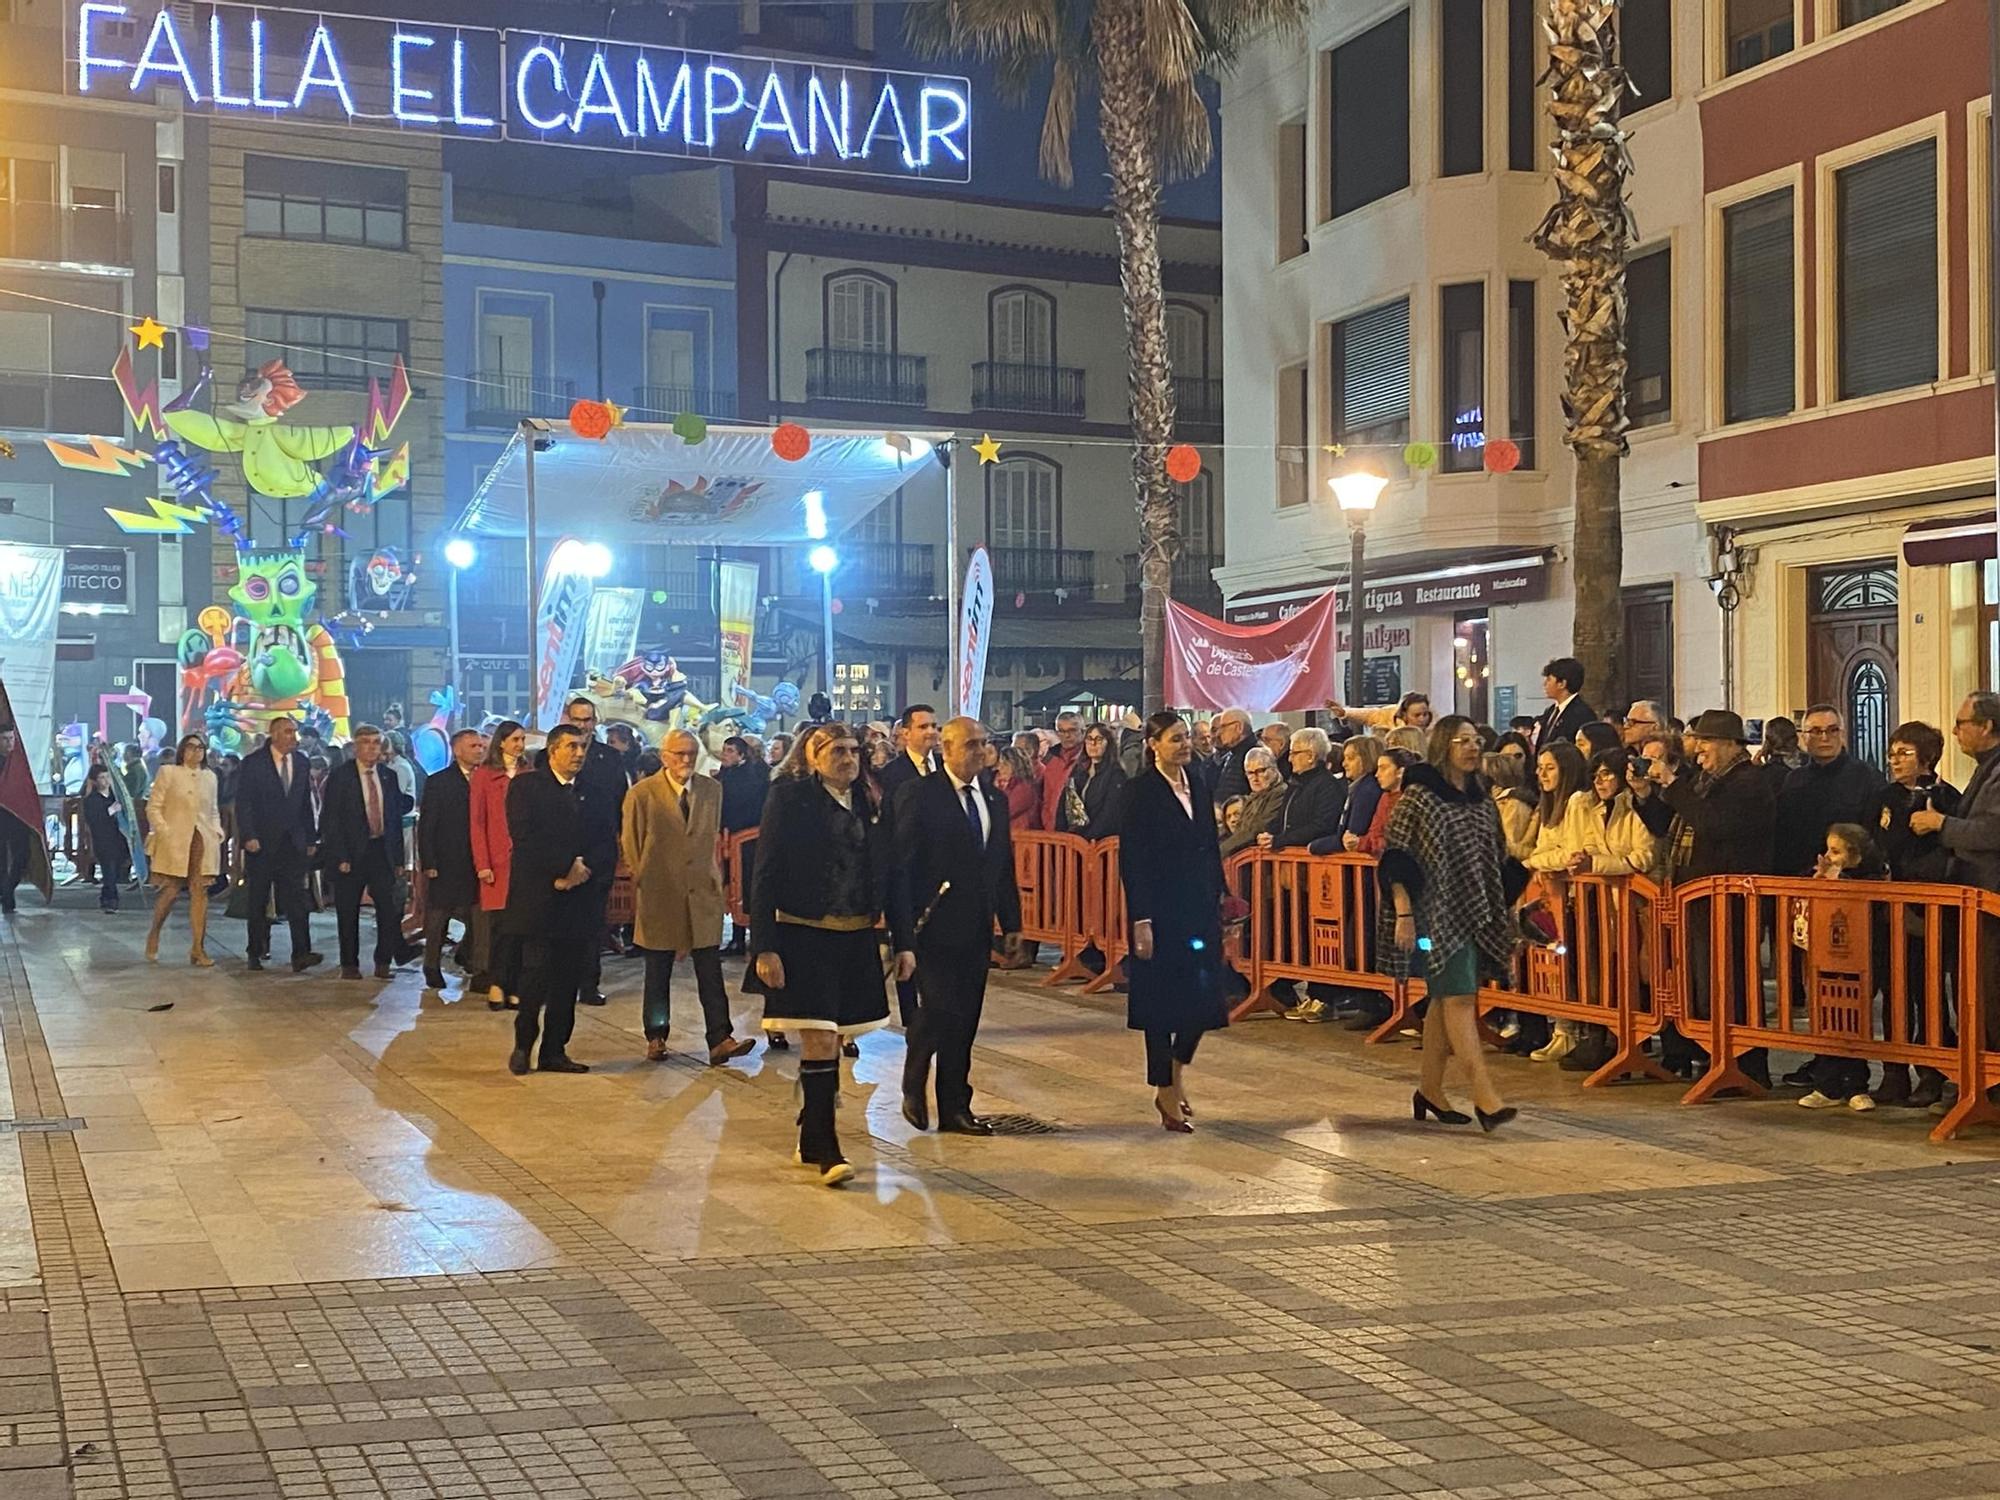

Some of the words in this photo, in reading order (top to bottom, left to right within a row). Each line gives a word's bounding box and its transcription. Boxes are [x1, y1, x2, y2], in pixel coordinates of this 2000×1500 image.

[77, 2, 355, 118] FALLA
[392, 32, 496, 127] EL
[516, 44, 971, 171] CAMPANAR
[1416, 582, 1481, 604] Restaurante
[1364, 623, 1411, 653] ntigua
[1206, 661, 1221, 676] de
